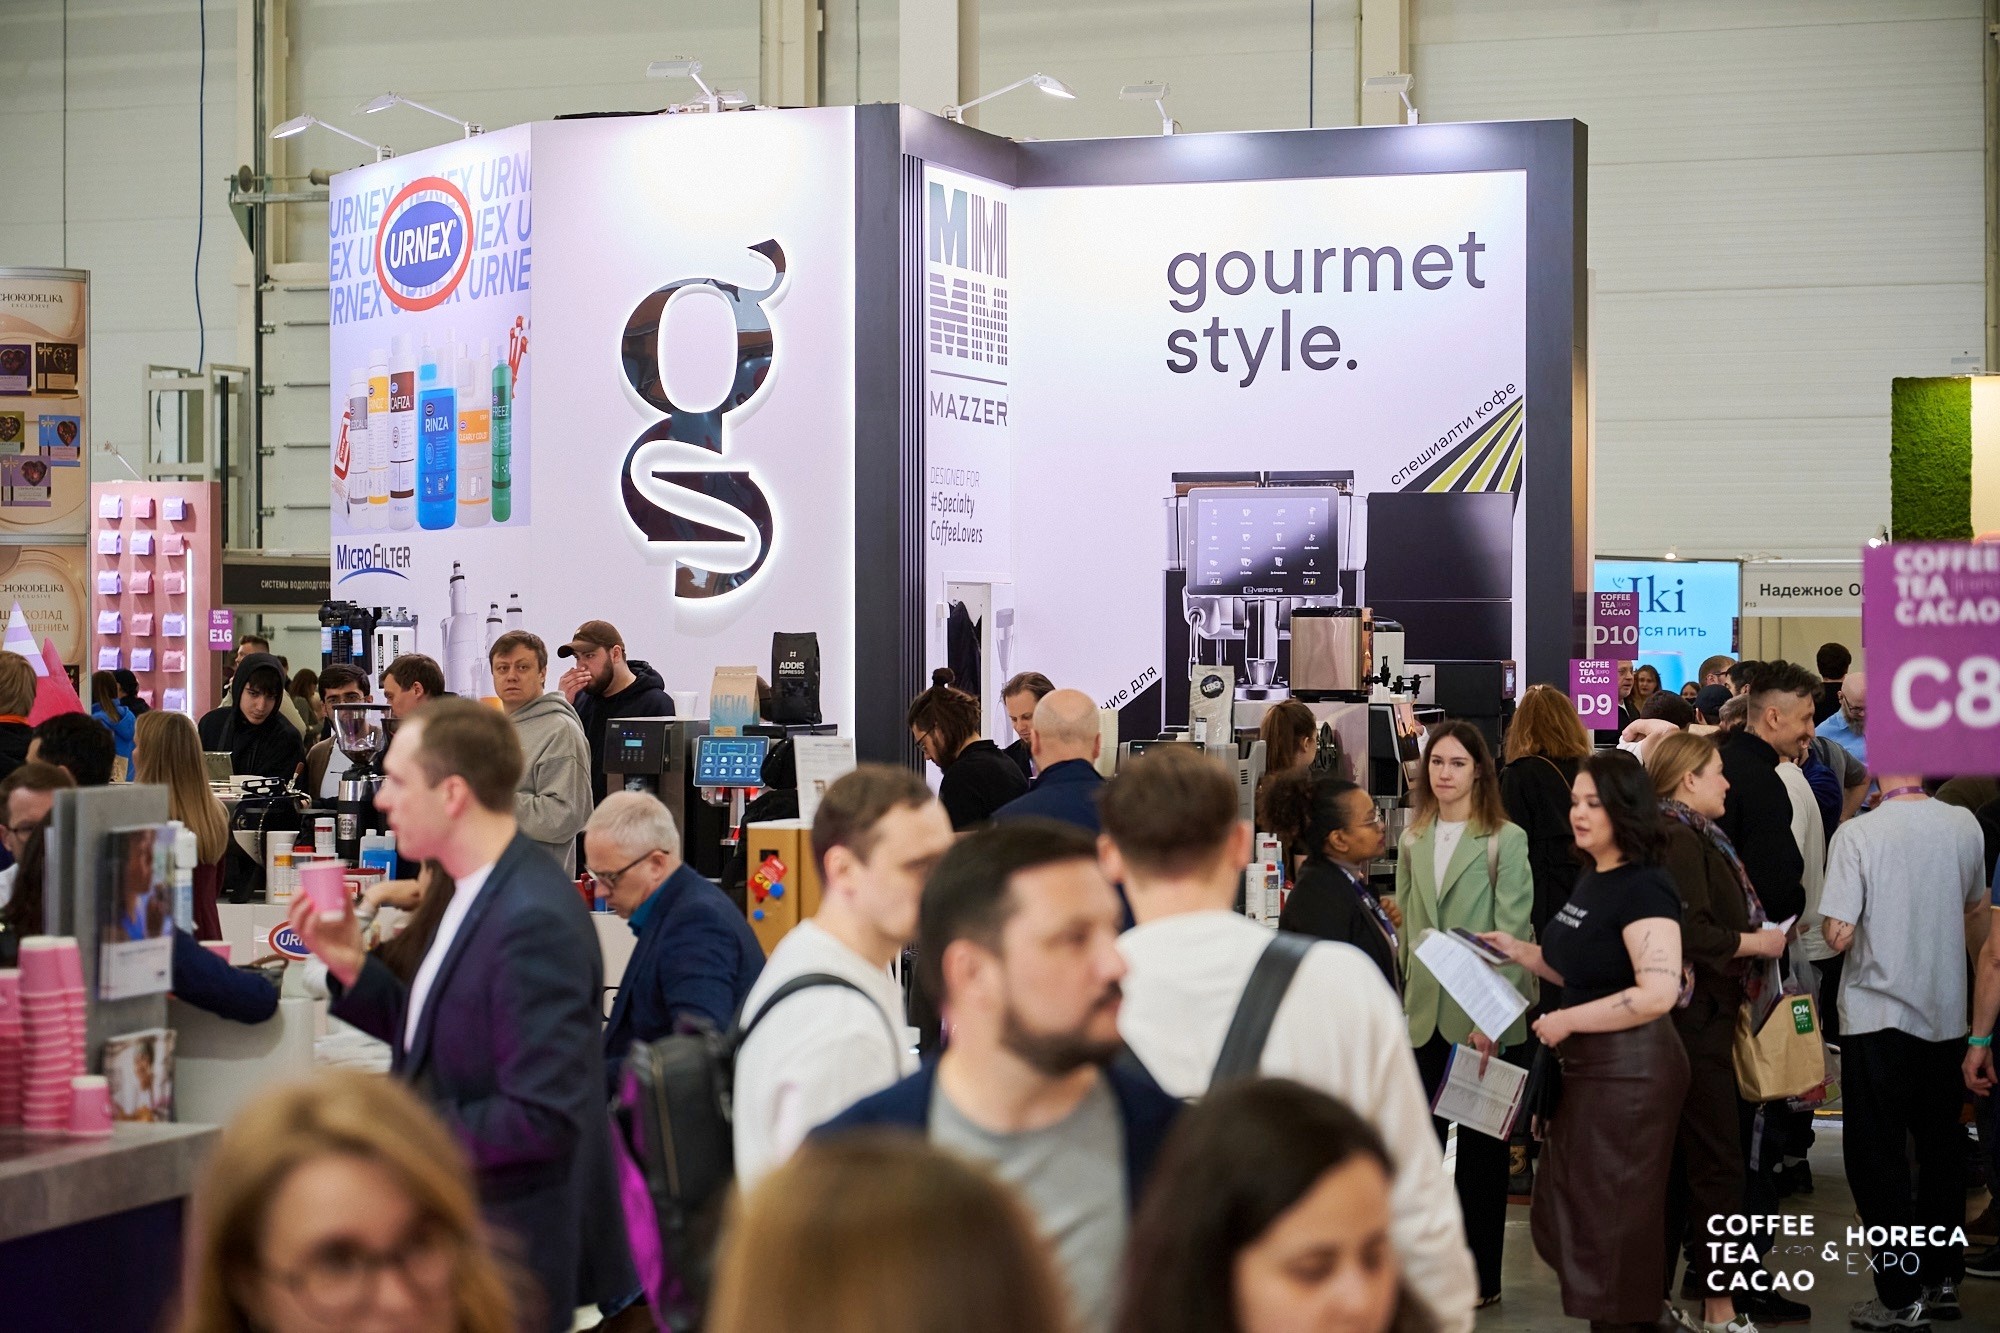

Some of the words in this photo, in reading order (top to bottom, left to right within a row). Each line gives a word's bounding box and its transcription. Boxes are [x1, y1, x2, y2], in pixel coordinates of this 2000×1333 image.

[480, 152, 532, 202] URN
[389, 219, 452, 269] URNEX
[468, 247, 532, 300] URNE
[1167, 231, 1486, 313] gourmet
[1166, 309, 1358, 388] style.
[930, 390, 1008, 427] MAZZER
[425, 416, 449, 433] RINZA
[1391, 415, 1475, 486] спешиалти
[1475, 382, 1517, 420] кофе
[930, 467, 965, 486] DESIGNED
[967, 471, 980, 488] FOR
[931, 492, 975, 519] #Specialty
[931, 520, 983, 546] CoffeeLovers
[1893, 547, 1999, 574] COFFEE
[261, 580, 289, 589] СИСТЕМЫ
[290, 580, 330, 591] ВОДОПОДГОТО
[1760, 583, 1843, 598] Надежное
[1895, 574, 1951, 599] TEA
[0, 610, 62, 621] ШКОЛАД
[1894, 598, 2000, 626] CACAO
[1, 624, 69, 632] УШЕНИЕМ
[210, 629, 232, 643] E16
[1593, 626, 1638, 645] D10
[1668, 627, 1707, 636] пить
[779, 661, 805, 669] ADDIS
[1130, 666, 1157, 694] для
[1891, 654, 2000, 731] C8
[1577, 694, 1612, 715] D9
